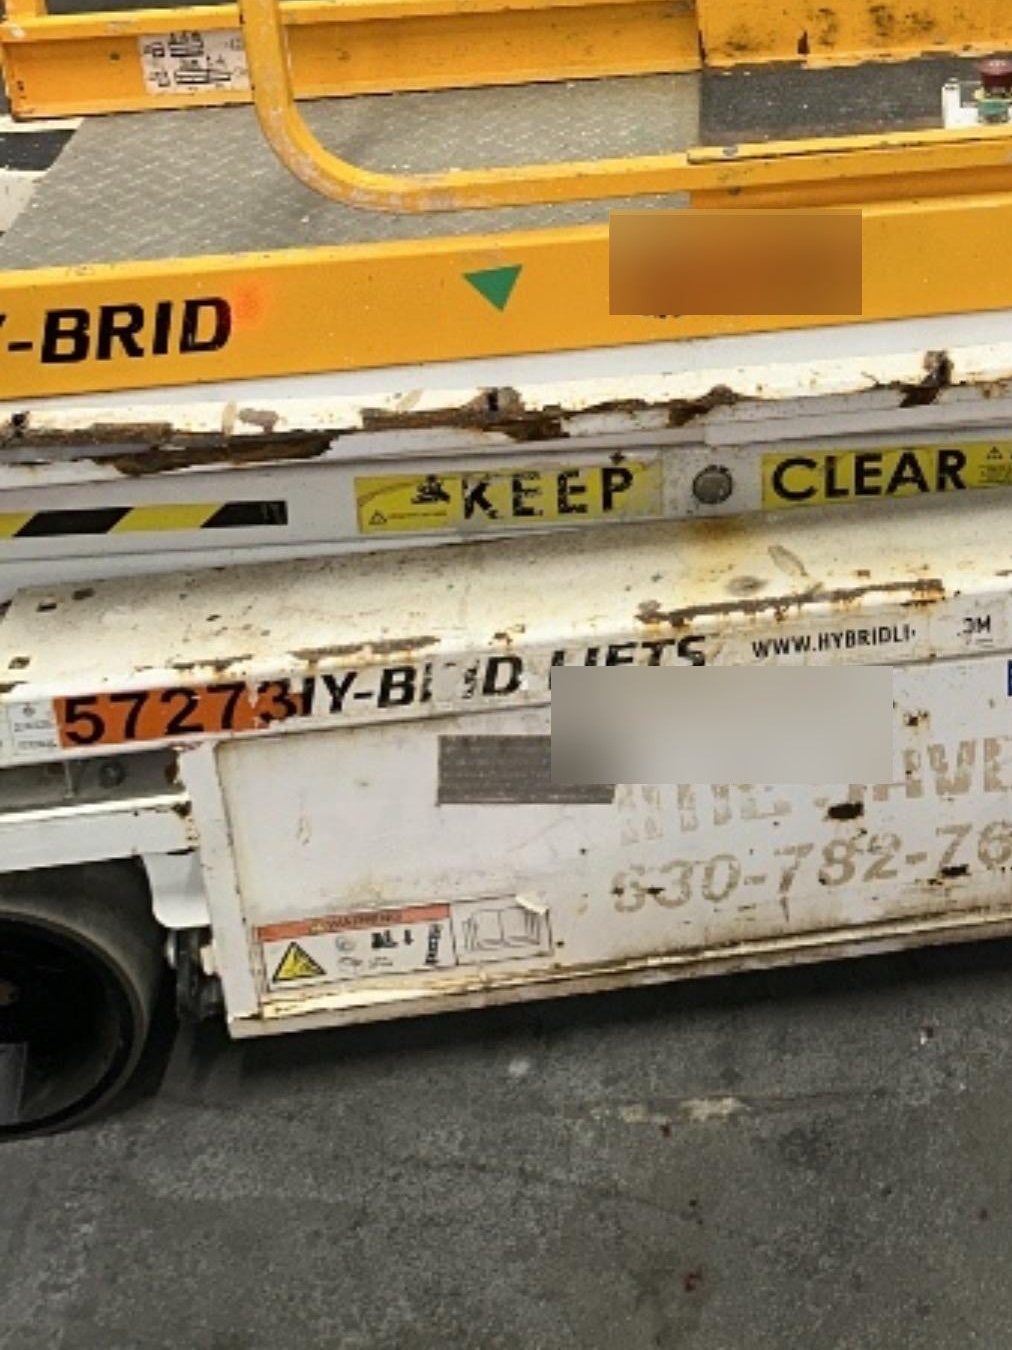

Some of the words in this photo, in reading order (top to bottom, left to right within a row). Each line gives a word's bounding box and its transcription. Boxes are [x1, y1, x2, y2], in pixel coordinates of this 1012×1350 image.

[0, 296, 232, 364] -BRID
[462, 466, 633, 520] KEEP
[771, 449, 968, 501] CLEAR
[64, 679, 298, 745] 57273
